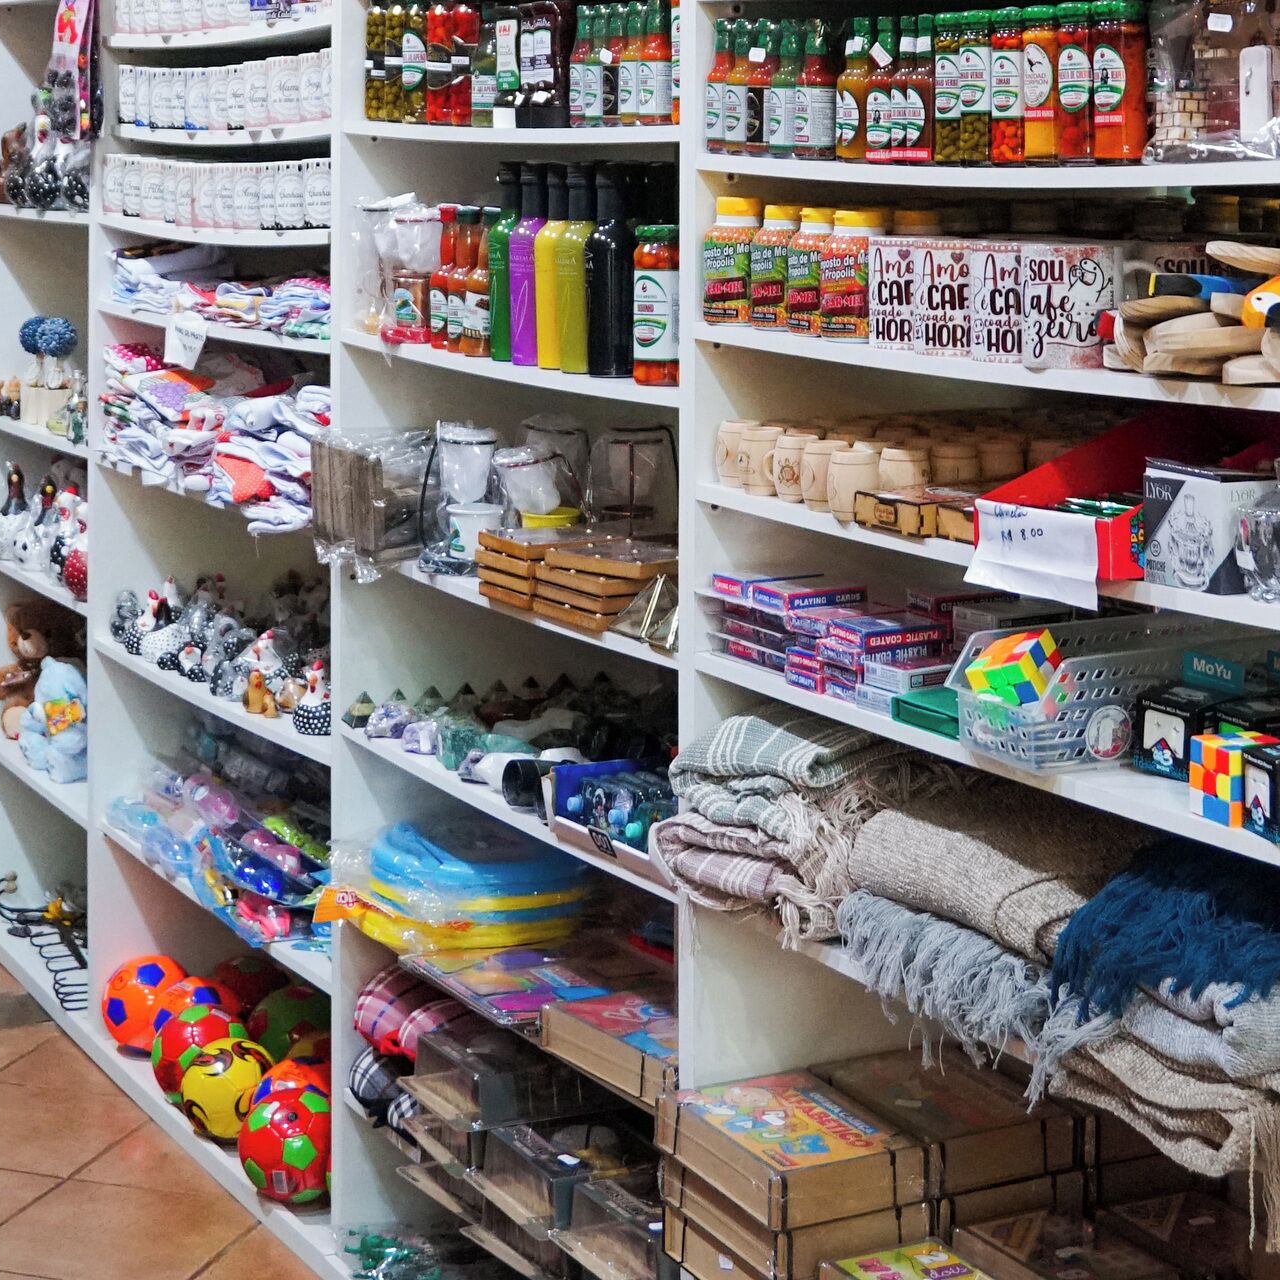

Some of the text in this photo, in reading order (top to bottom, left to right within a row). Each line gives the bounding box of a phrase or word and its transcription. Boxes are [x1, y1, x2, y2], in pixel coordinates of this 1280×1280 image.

[724, 245, 734, 255] de
[763, 250, 771, 258] de
[799, 255, 808, 263] de
[844, 252, 869, 266] de Me
[873, 248, 914, 279] Amo
[923, 251, 969, 283] Amo
[984, 254, 1020, 289] Am
[1029, 259, 1064, 282] SOU
[878, 280, 914, 306] CAF
[927, 283, 969, 310] CAF
[873, 306, 903, 317] coado
[922, 311, 955, 323] coado
[984, 317, 1019, 328] coado
[876, 319, 912, 342] HOR
[1145, 481, 1173, 502] LYOR
[1230, 489, 1256, 502] LYOR
[1020, 528, 1043, 540] 8.00
[794, 592, 861, 606] PLAYING CARDS
[870, 631, 938, 646] PLASTIC COATED
[1193, 657, 1232, 680] MoYu
